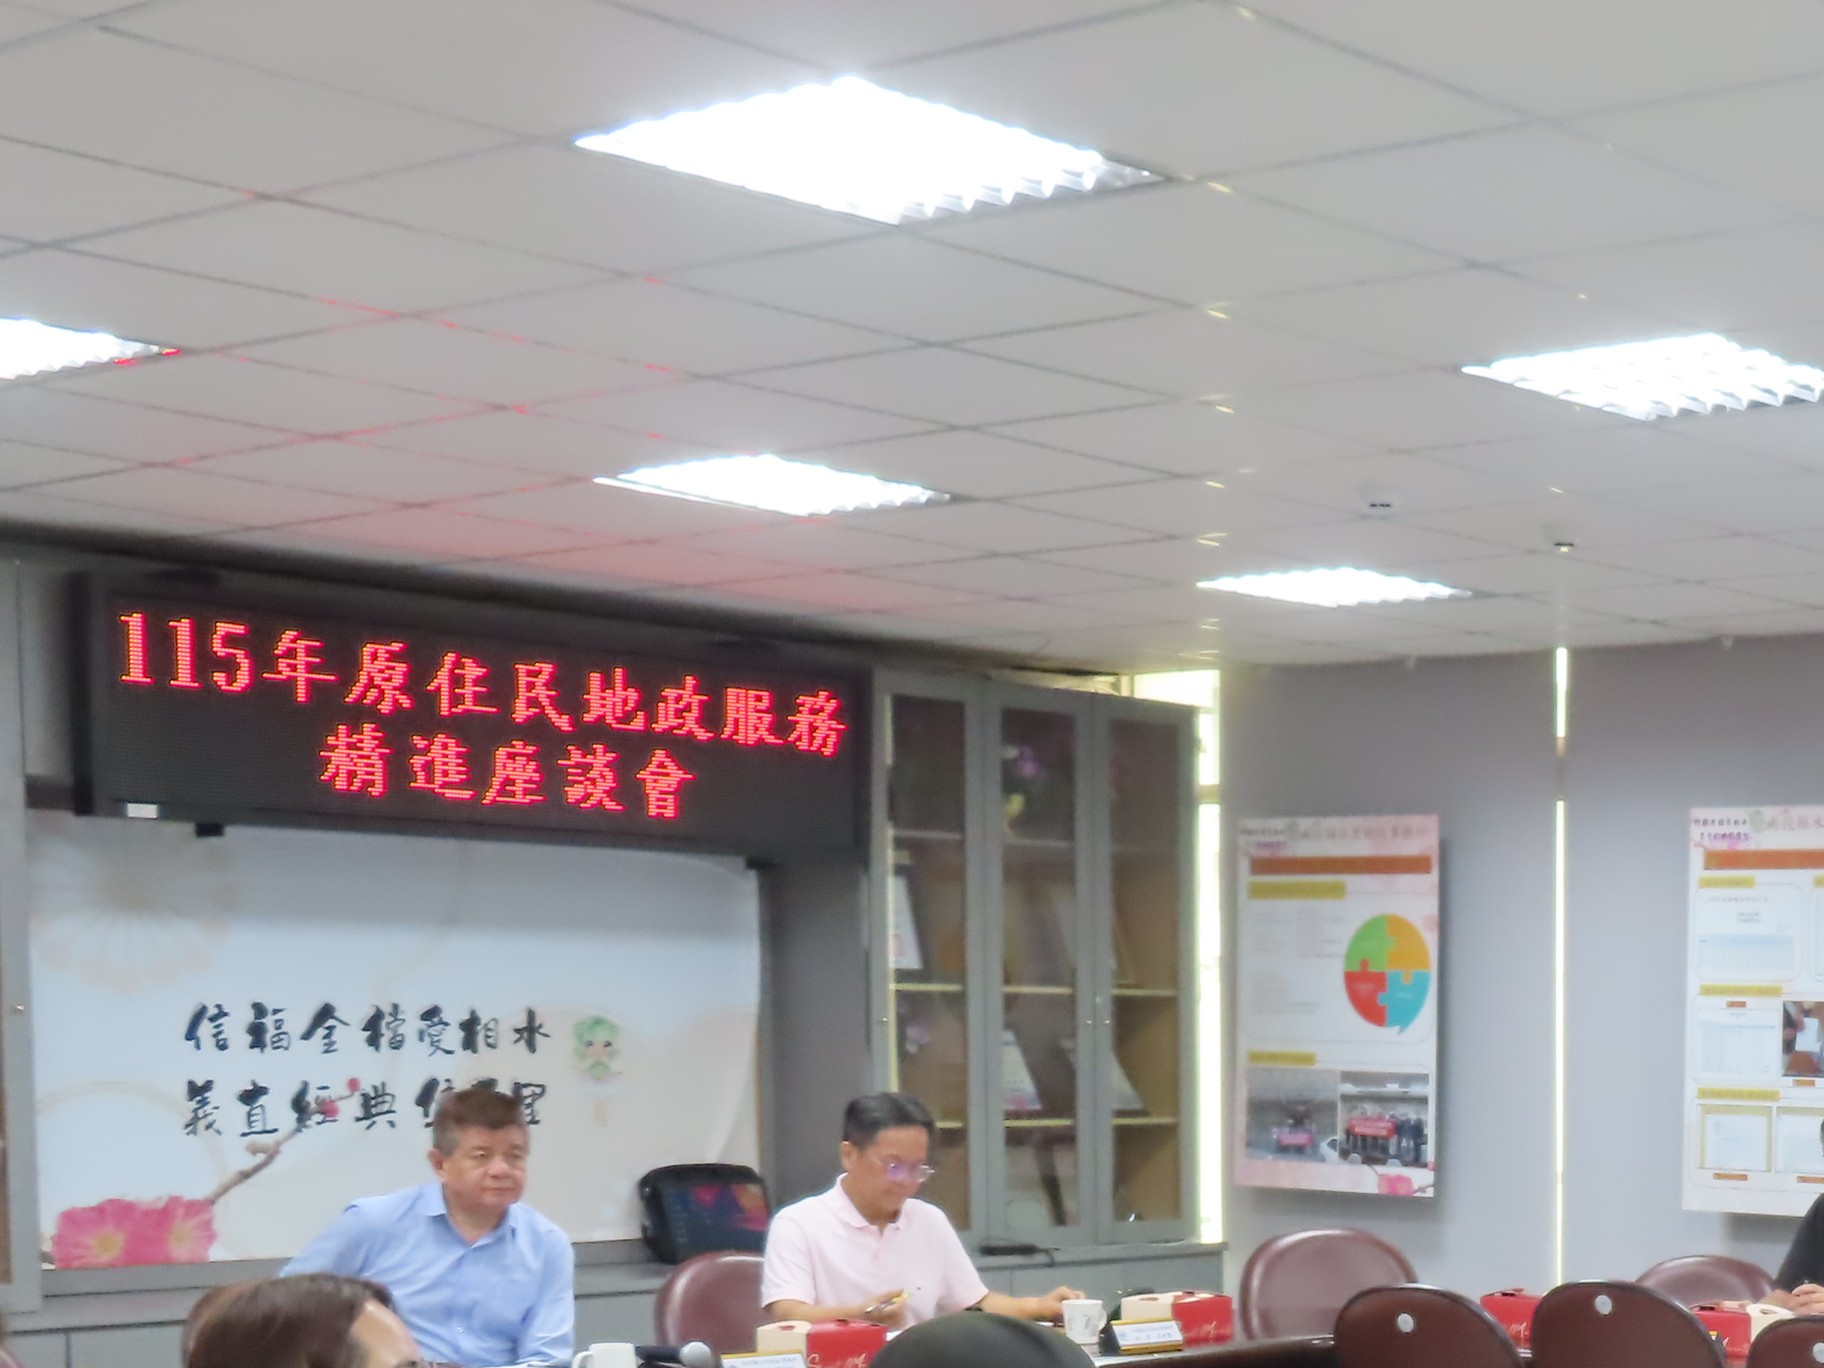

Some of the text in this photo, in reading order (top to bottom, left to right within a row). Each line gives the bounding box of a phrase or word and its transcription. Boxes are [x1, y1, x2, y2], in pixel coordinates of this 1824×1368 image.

[120, 611, 847, 756] 115年原住民地政服務
[319, 723, 696, 819] 精進座談會
